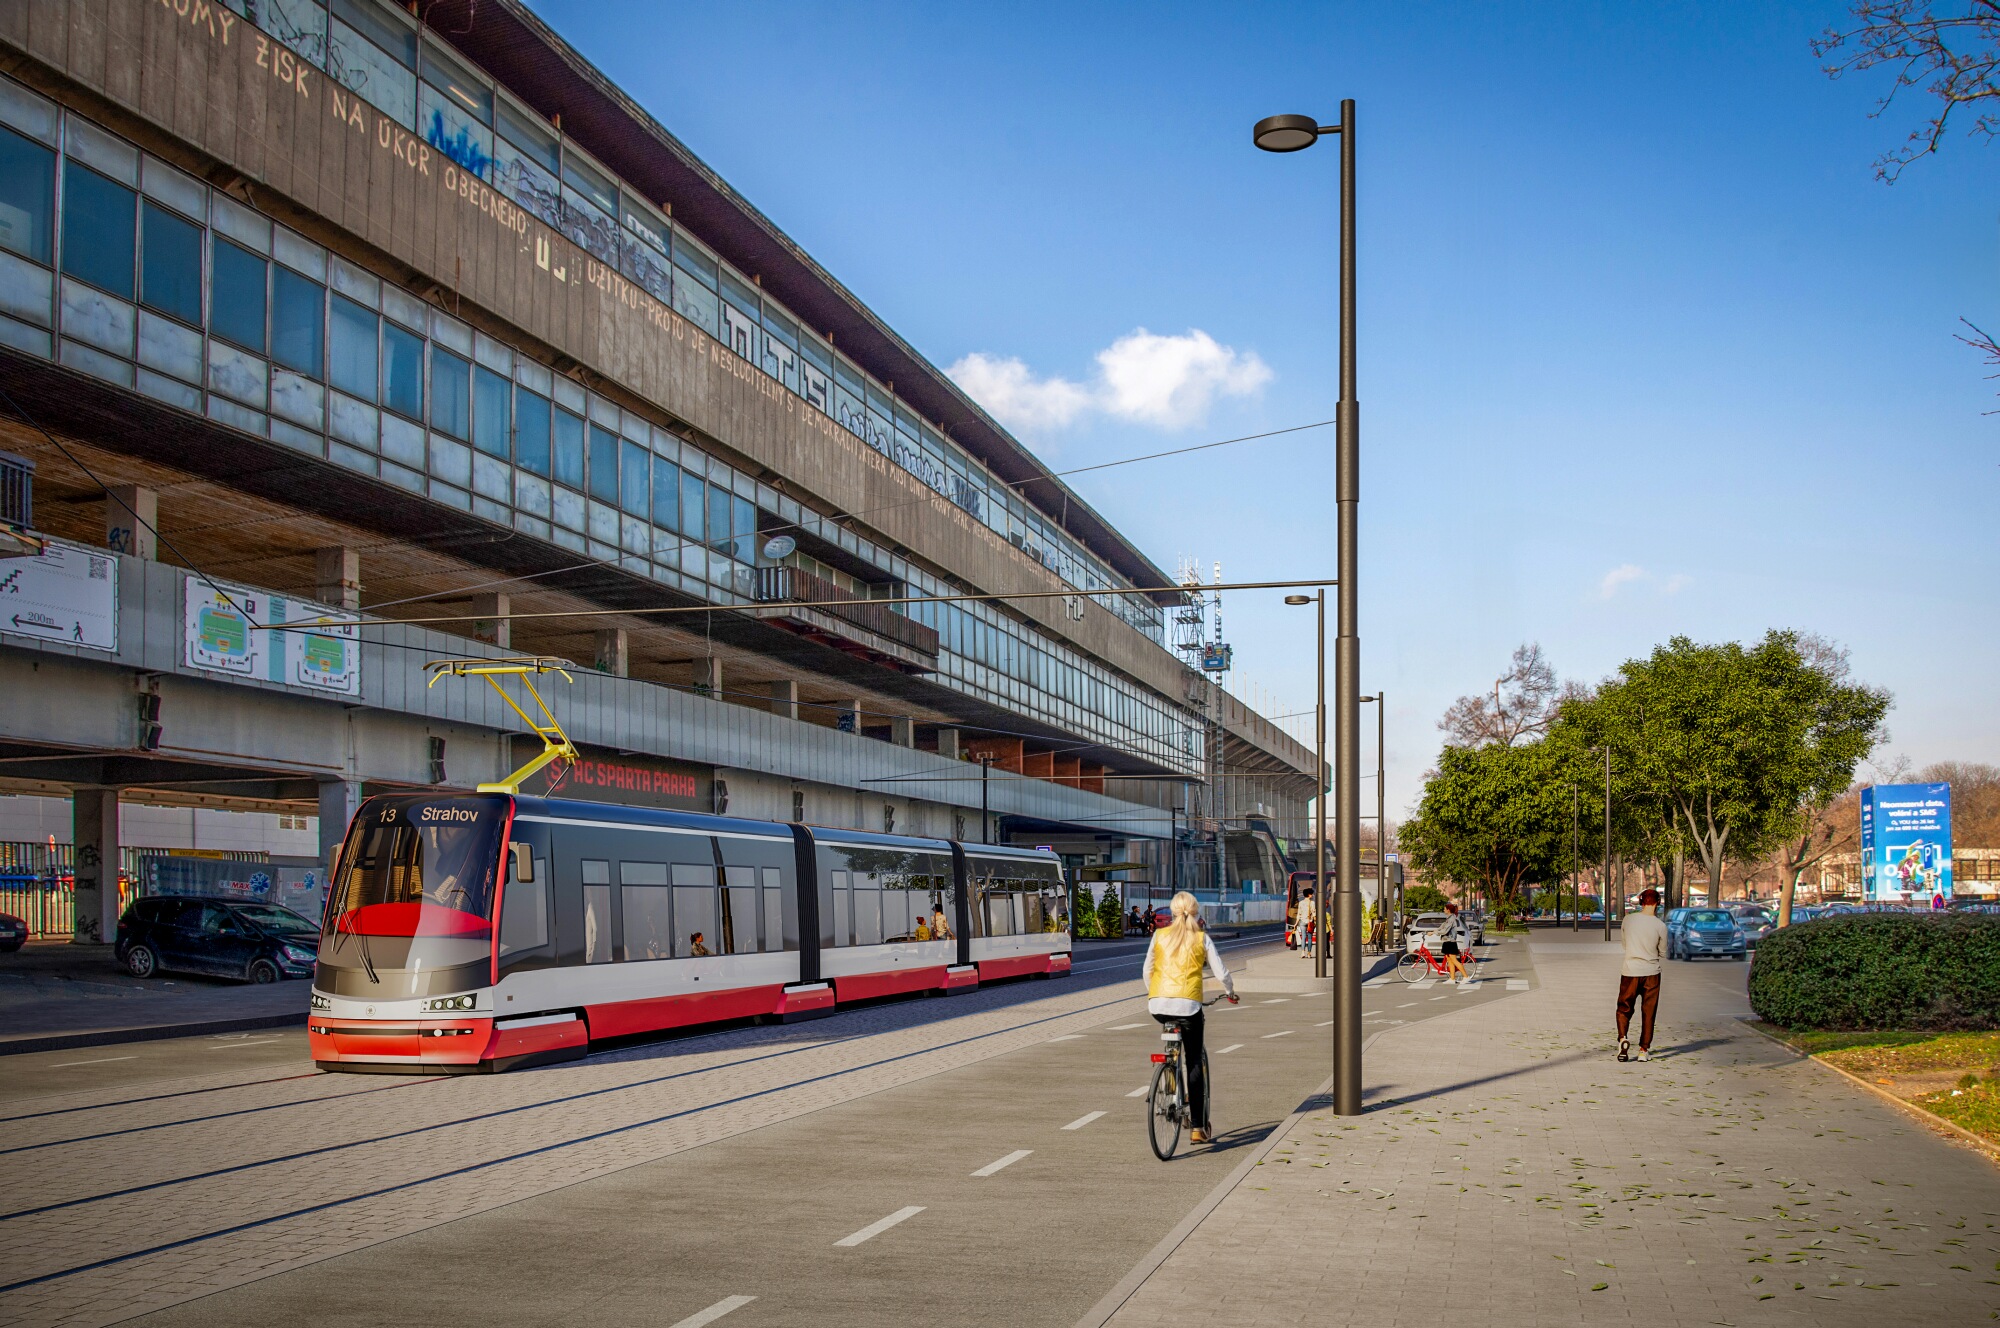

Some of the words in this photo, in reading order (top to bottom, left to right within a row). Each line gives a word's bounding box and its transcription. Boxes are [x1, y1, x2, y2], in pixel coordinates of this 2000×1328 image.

[333, 89, 364, 134] NA
[378, 118, 430, 176] ÚKOR
[691, 329, 705, 354] JE
[786, 393, 794, 412] S
[27, 611, 55, 625] 200m
[573, 759, 593, 784] AC
[596, 763, 651, 792] SPARTA
[653, 769, 696, 798] PRAHA
[380, 808, 397, 822] 13
[421, 807, 479, 822] Strahov
[1919, 808, 1938, 817] SMS
